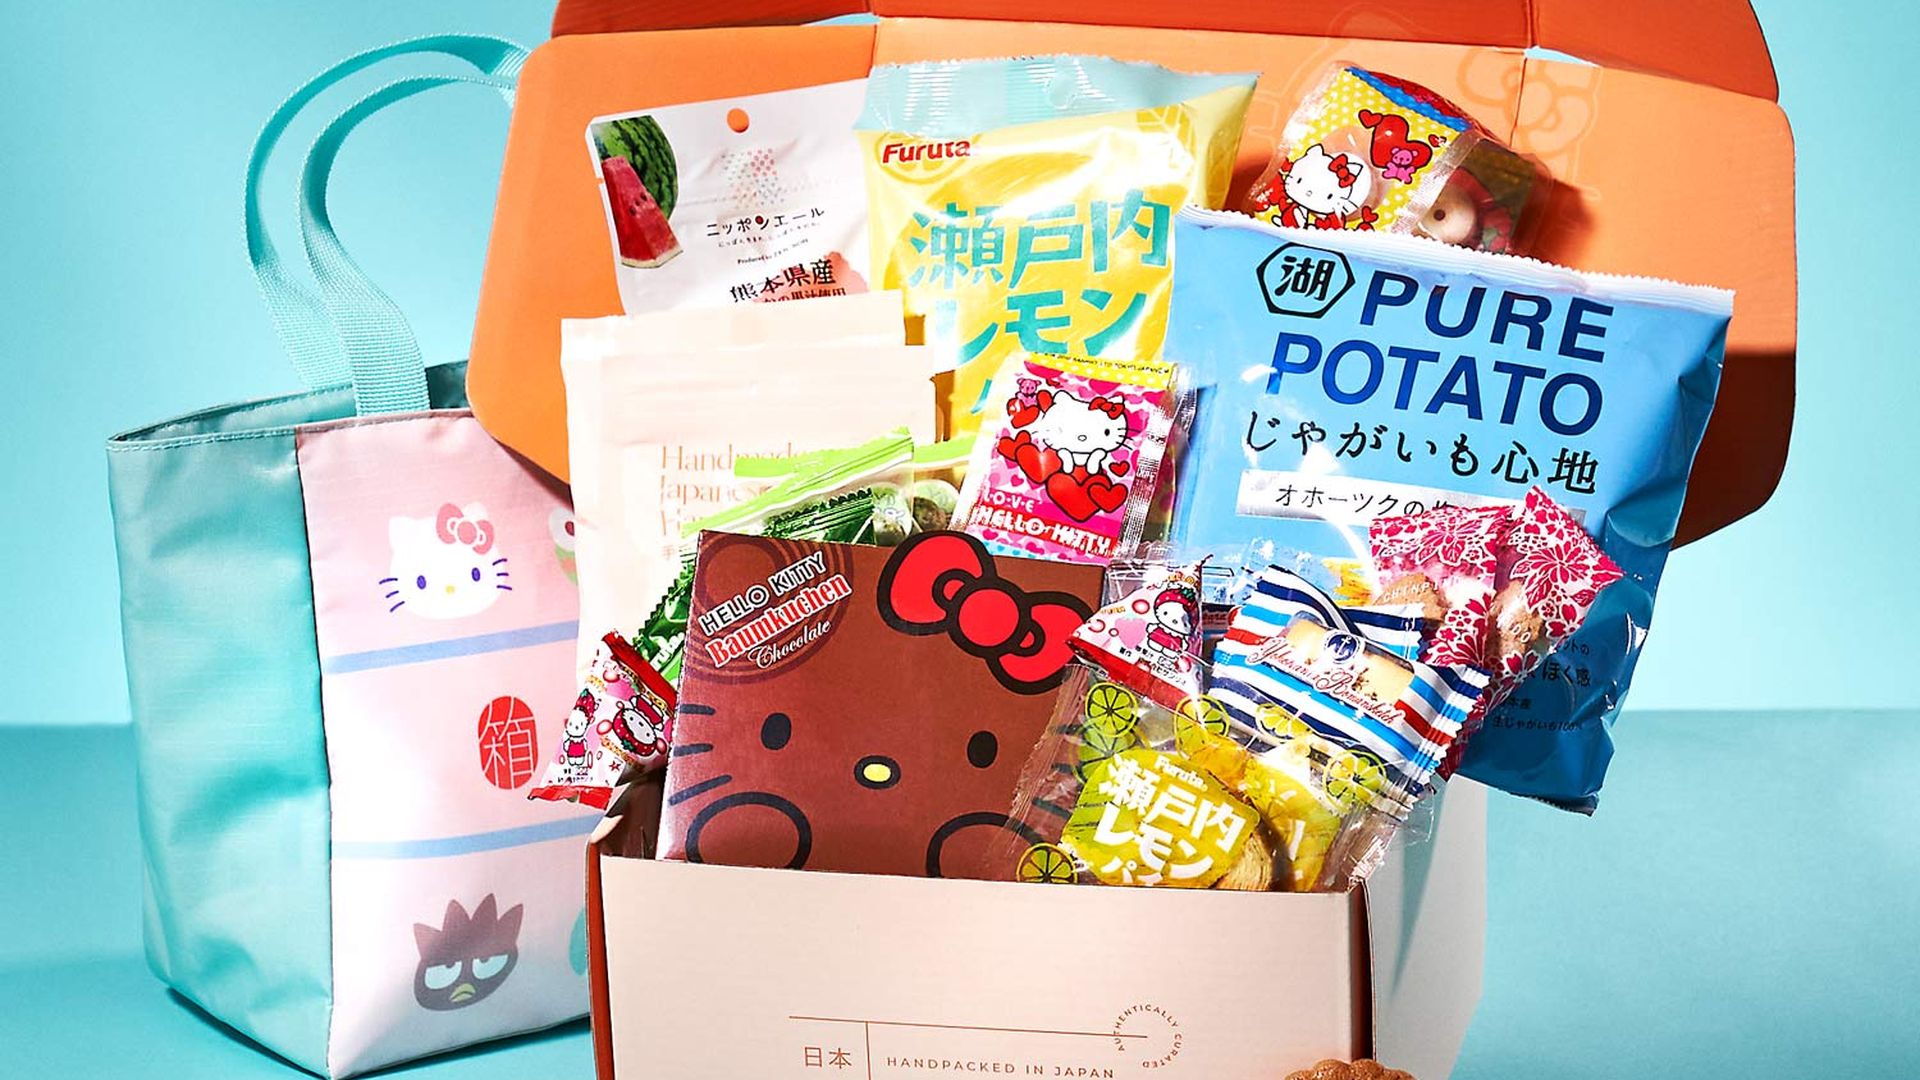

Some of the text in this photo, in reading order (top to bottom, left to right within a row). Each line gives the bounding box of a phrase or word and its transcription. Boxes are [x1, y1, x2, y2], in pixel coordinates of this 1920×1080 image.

[882, 138, 970, 164] Furuta
[907, 188, 1173, 289] 瀬戸内
[1277, 255, 1334, 302] 湖
[730, 258, 837, 303] 熊本県産
[1360, 270, 1615, 363] PURE
[933, 287, 1148, 368] レモン
[1265, 331, 1604, 437] POTATO
[1245, 409, 1599, 495] じゃがいも心地
[1275, 484, 1454, 517] オホーツクの
[699, 551, 827, 636] HELLO KITTY
[705, 574, 852, 668] Baumkuchen
[748, 619, 832, 669] Chocolate
[478, 695, 539, 790] 箱
[1093, 801, 1214, 880] レモン
[1098, 752, 1247, 854] 瀬戸内
[804, 1046, 852, 1070] 日本
[886, 1056, 1114, 1079] HANDPACKED IN JAPAN
[1113, 1004, 1182, 1068] AUTHENTICALLY CURATED
